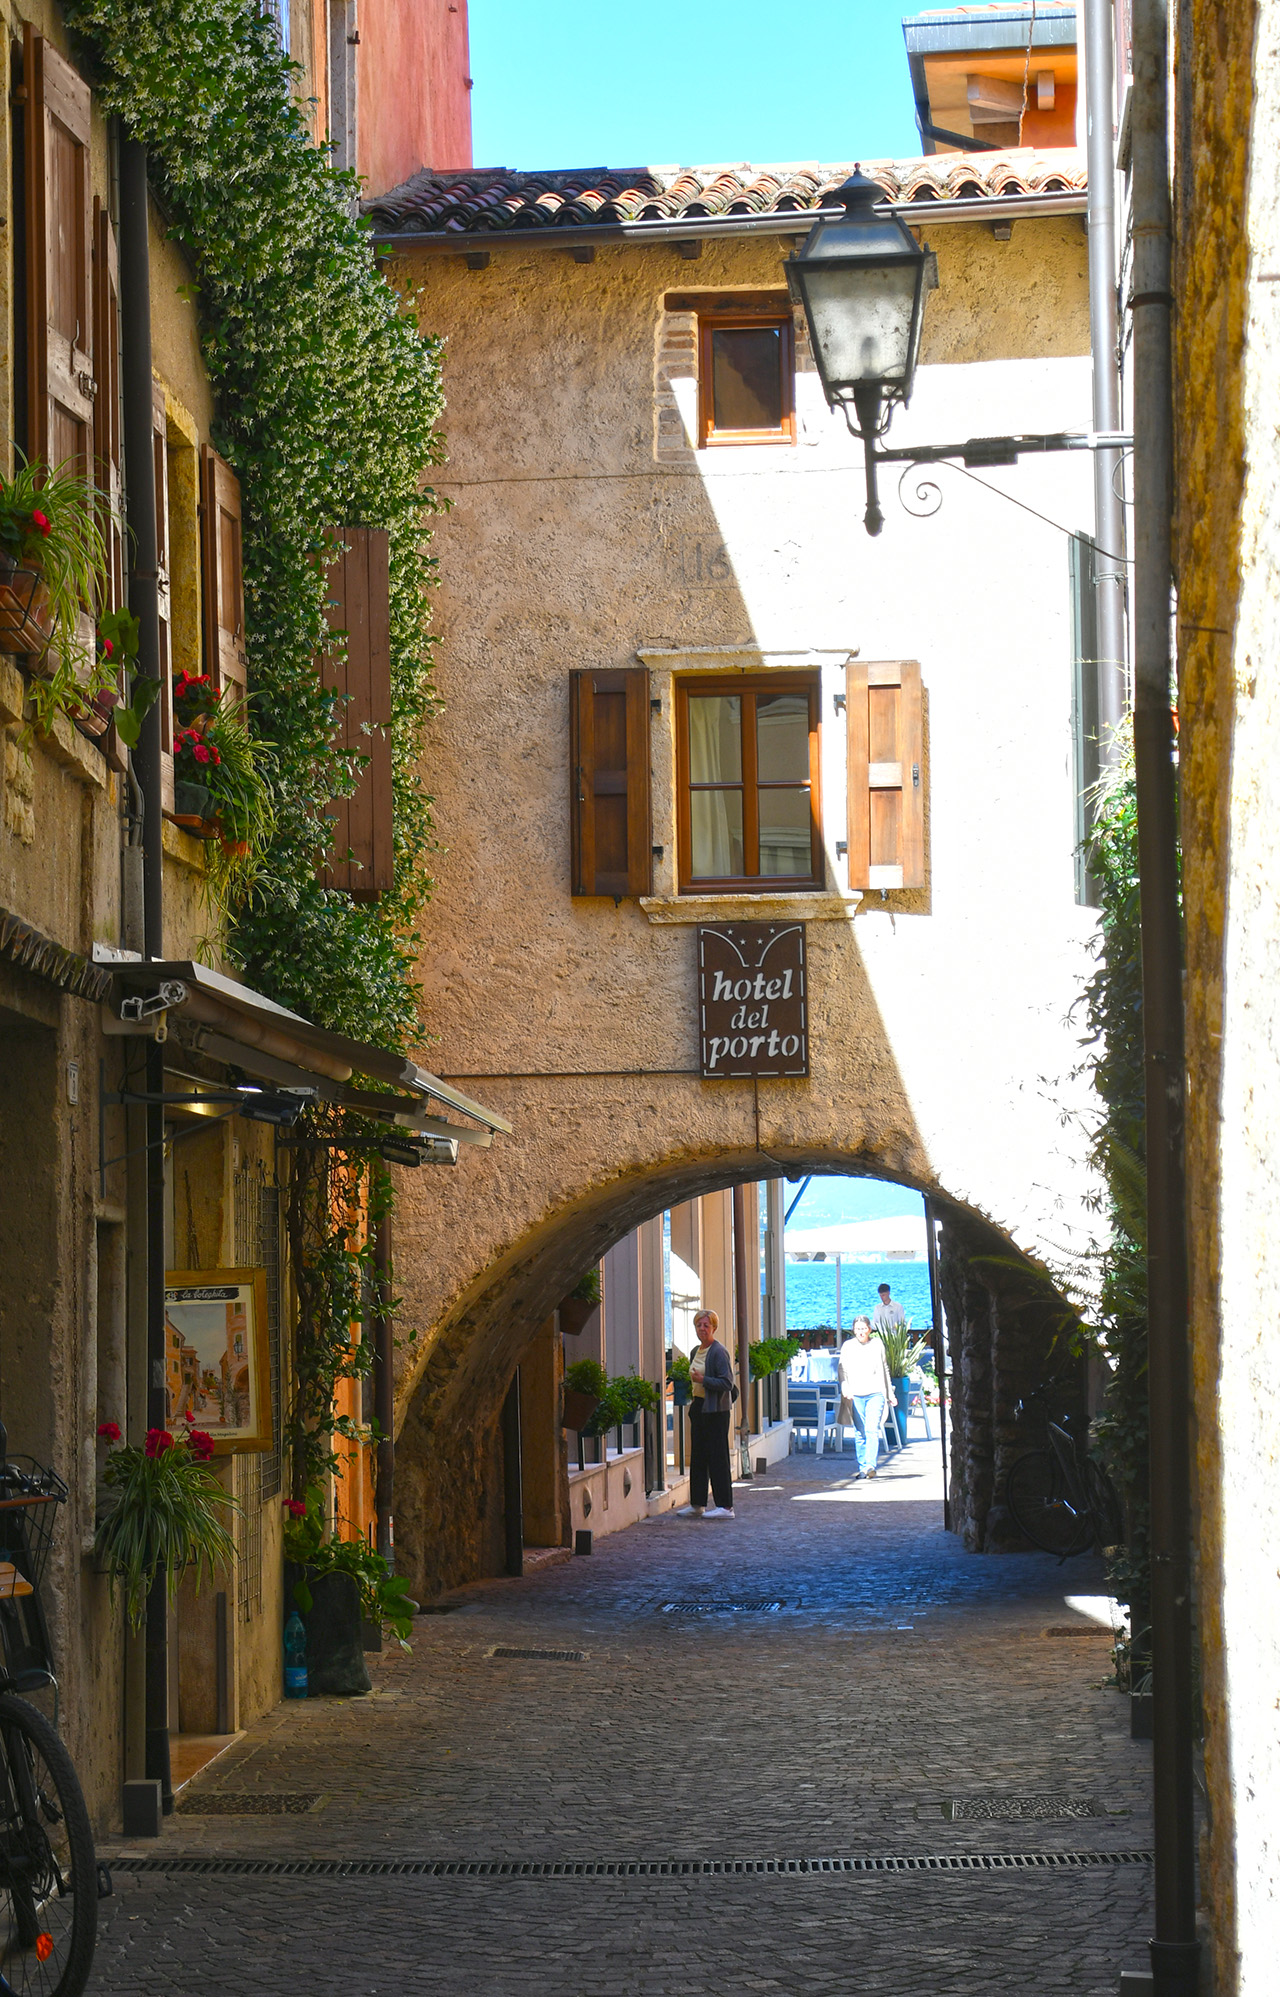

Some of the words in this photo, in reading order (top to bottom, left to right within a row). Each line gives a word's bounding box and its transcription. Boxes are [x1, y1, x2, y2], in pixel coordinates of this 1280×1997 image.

[712, 968, 793, 1001] hotel
[730, 1004, 769, 1029] del
[709, 1029, 799, 1069] porto
